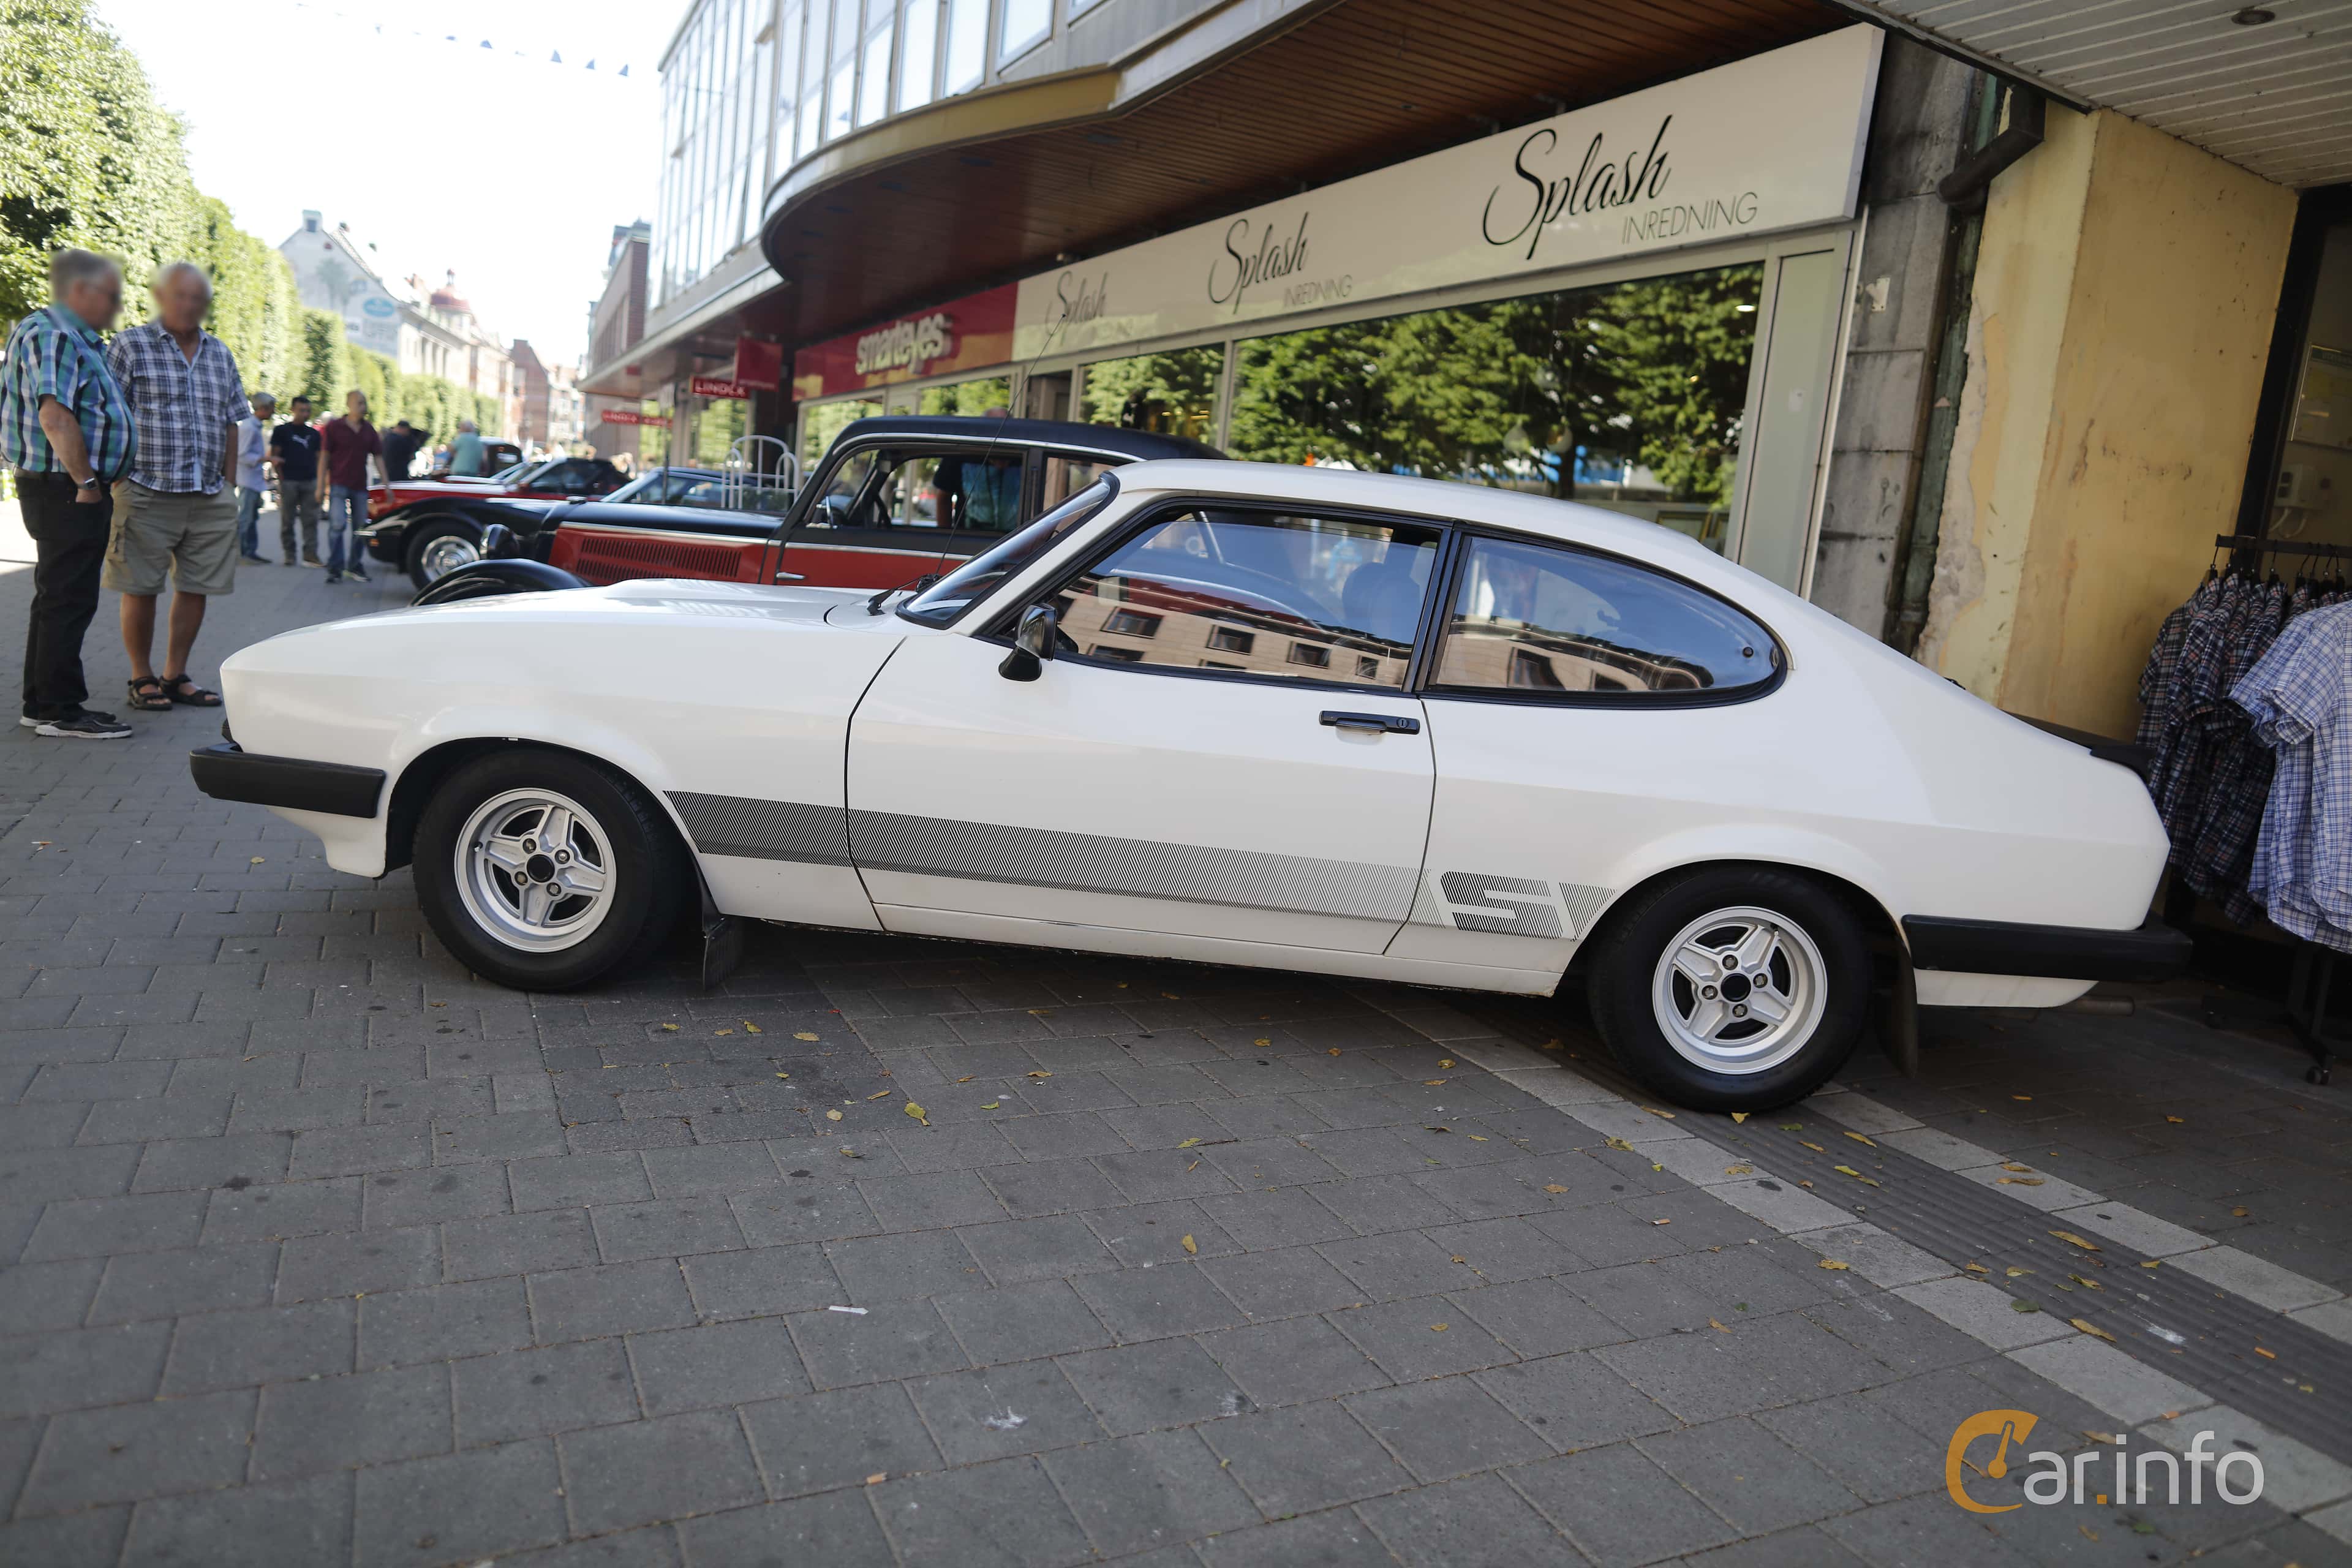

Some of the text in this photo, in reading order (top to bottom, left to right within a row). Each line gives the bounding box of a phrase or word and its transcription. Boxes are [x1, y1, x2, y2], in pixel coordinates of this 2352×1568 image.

[1483, 114, 1673, 260] Splash
[1622, 192, 1758, 245] INREDNING
[1208, 211, 1310, 315] Splash
[855, 313, 948, 376] smarteyes
